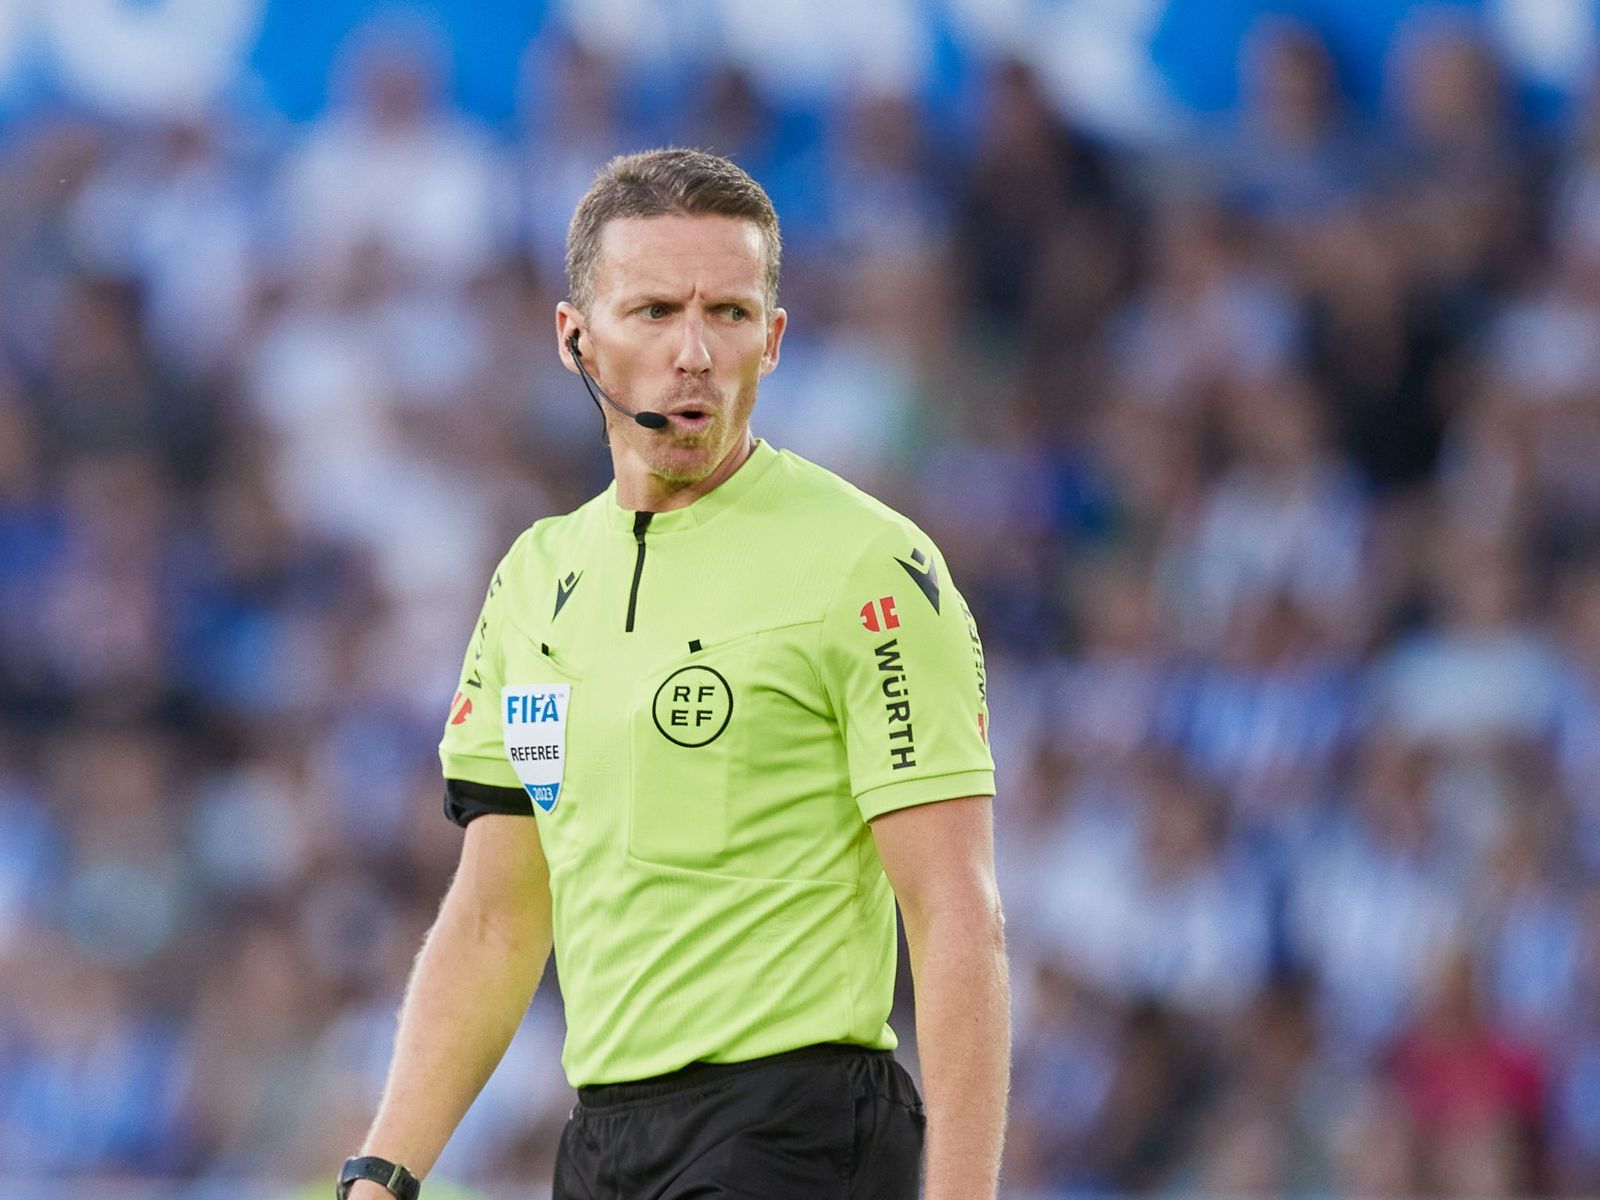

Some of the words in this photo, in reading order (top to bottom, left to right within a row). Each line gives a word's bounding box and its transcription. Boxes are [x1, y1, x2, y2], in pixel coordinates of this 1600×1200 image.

[507, 694, 560, 724] FIFA
[874, 638, 917, 770] WÜRTH
[510, 745, 560, 762] REFEREE
[533, 786, 554, 801] 2023
